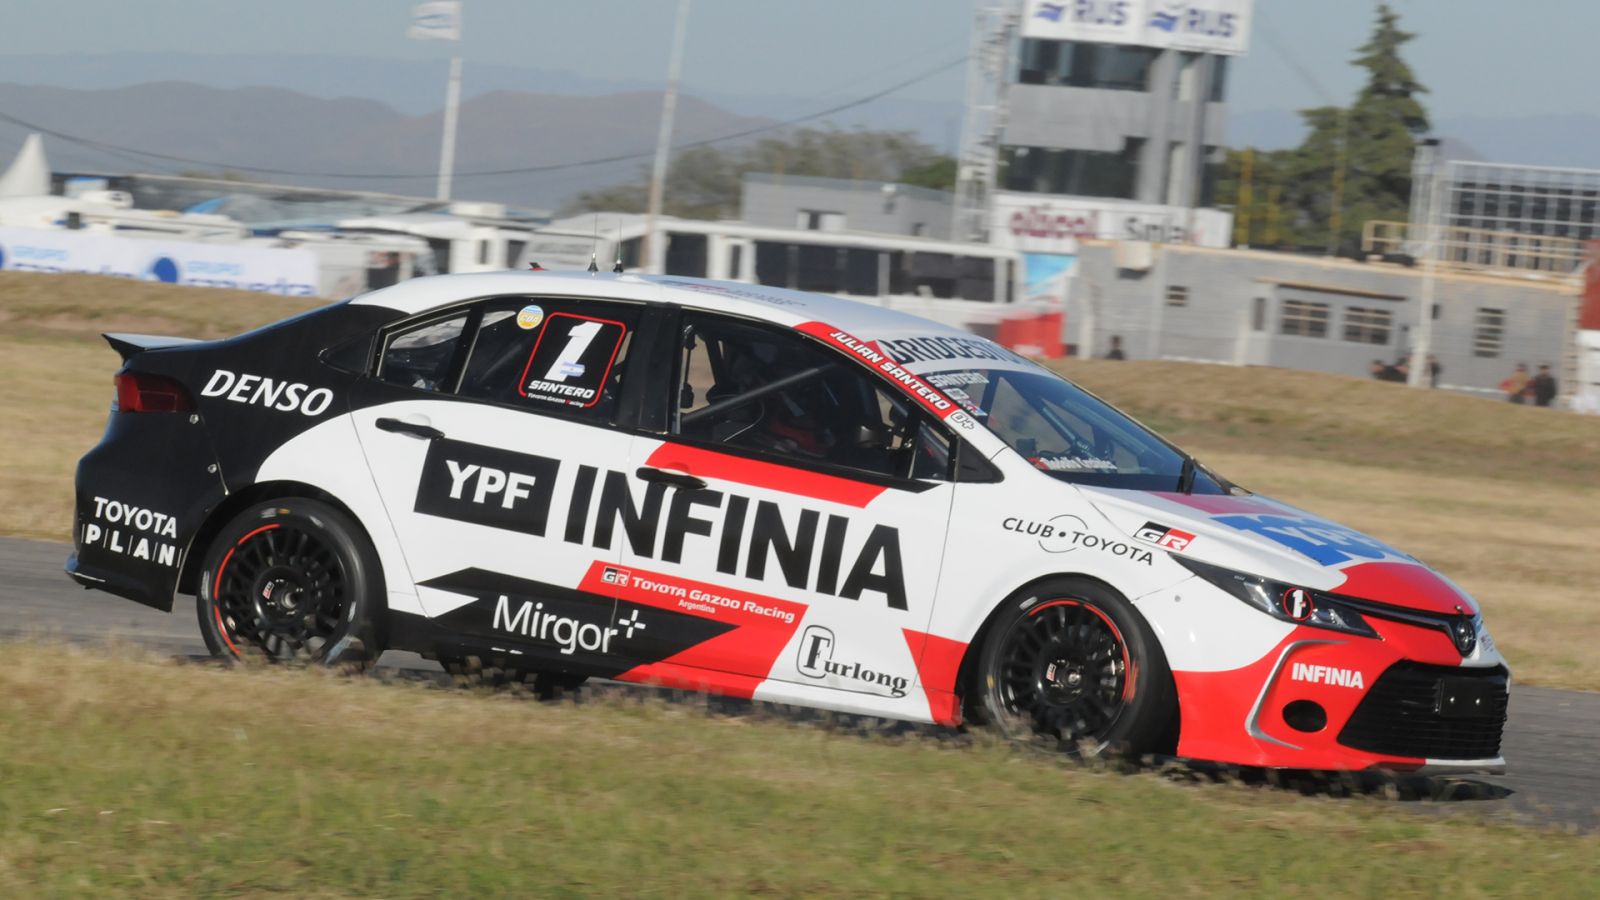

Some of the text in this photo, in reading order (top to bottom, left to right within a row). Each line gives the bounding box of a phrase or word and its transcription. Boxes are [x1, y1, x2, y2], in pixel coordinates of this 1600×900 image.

[543, 320, 604, 382] 1
[829, 331, 884, 363] JULIAN
[880, 361, 951, 410] SANTERO
[877, 337, 1022, 365] BRIDGEST
[200, 369, 334, 416] DENSO
[528, 380, 595, 399] SANTERO
[94, 496, 177, 539] TOYOTA
[444, 459, 909, 611] YPF INFINIA
[1135, 525, 1192, 551] GR
[1002, 517, 1154, 566] CLUB TOYOTA
[602, 568, 795, 624] GR TOYOTA GAZOO Racing
[678, 599, 716, 614] Argentina
[1292, 589, 1304, 618] 1
[492, 594, 619, 655] Mirgor
[803, 634, 910, 698] Furlong
[1291, 662, 1364, 689] INFINIA
